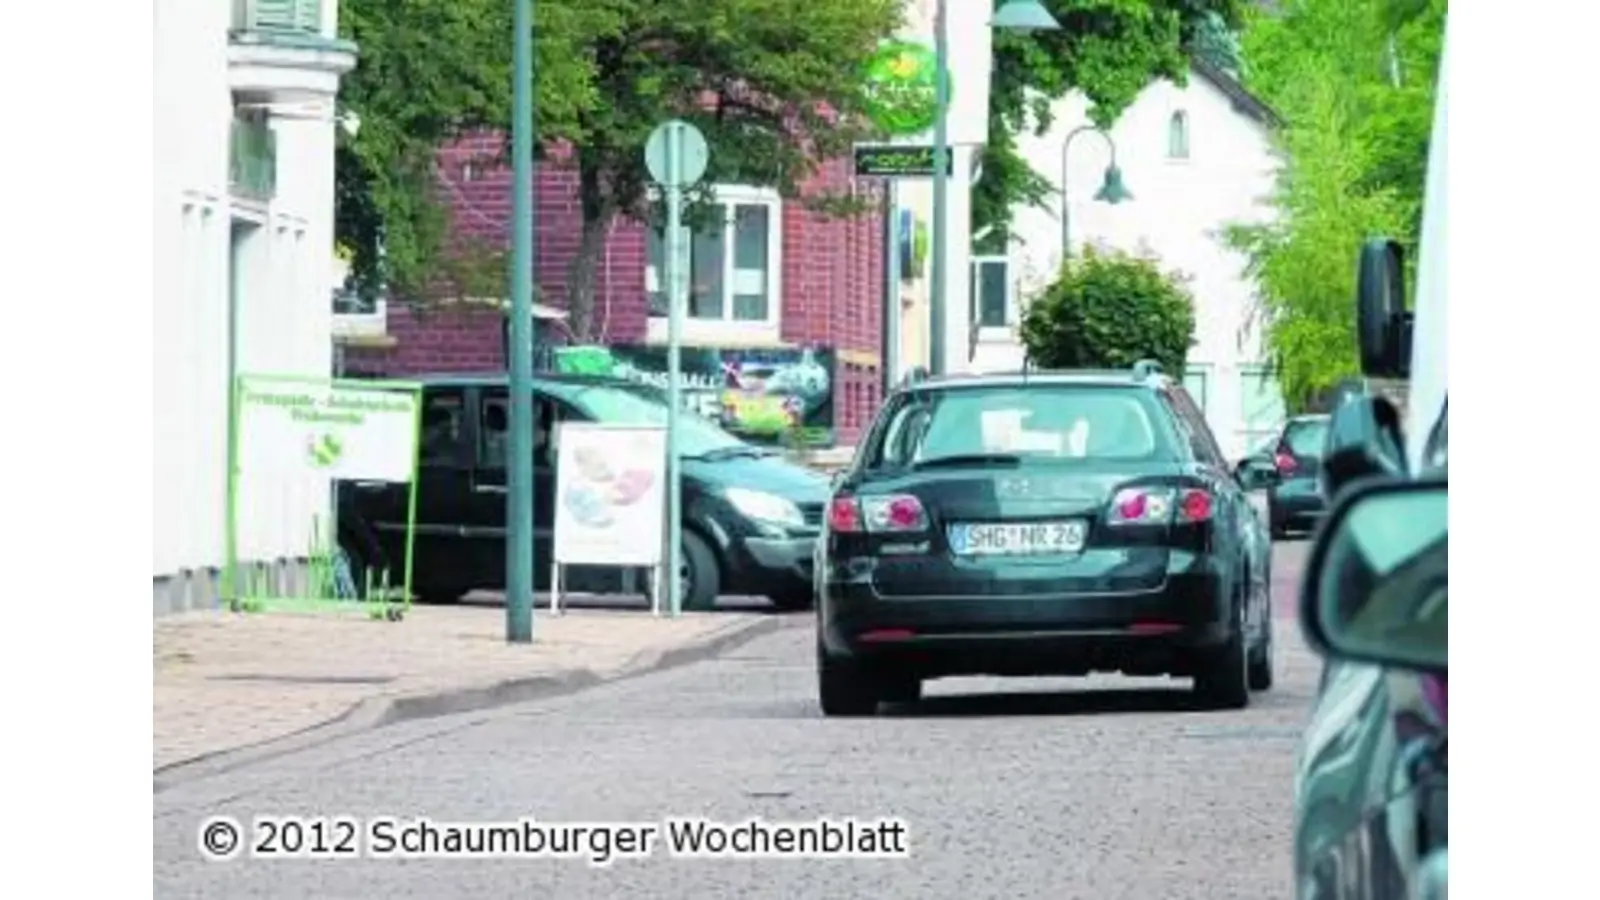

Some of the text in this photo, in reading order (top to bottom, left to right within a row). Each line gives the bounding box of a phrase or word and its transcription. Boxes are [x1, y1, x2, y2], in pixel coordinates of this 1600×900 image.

[966, 525, 1081, 547] SHG NR 26
